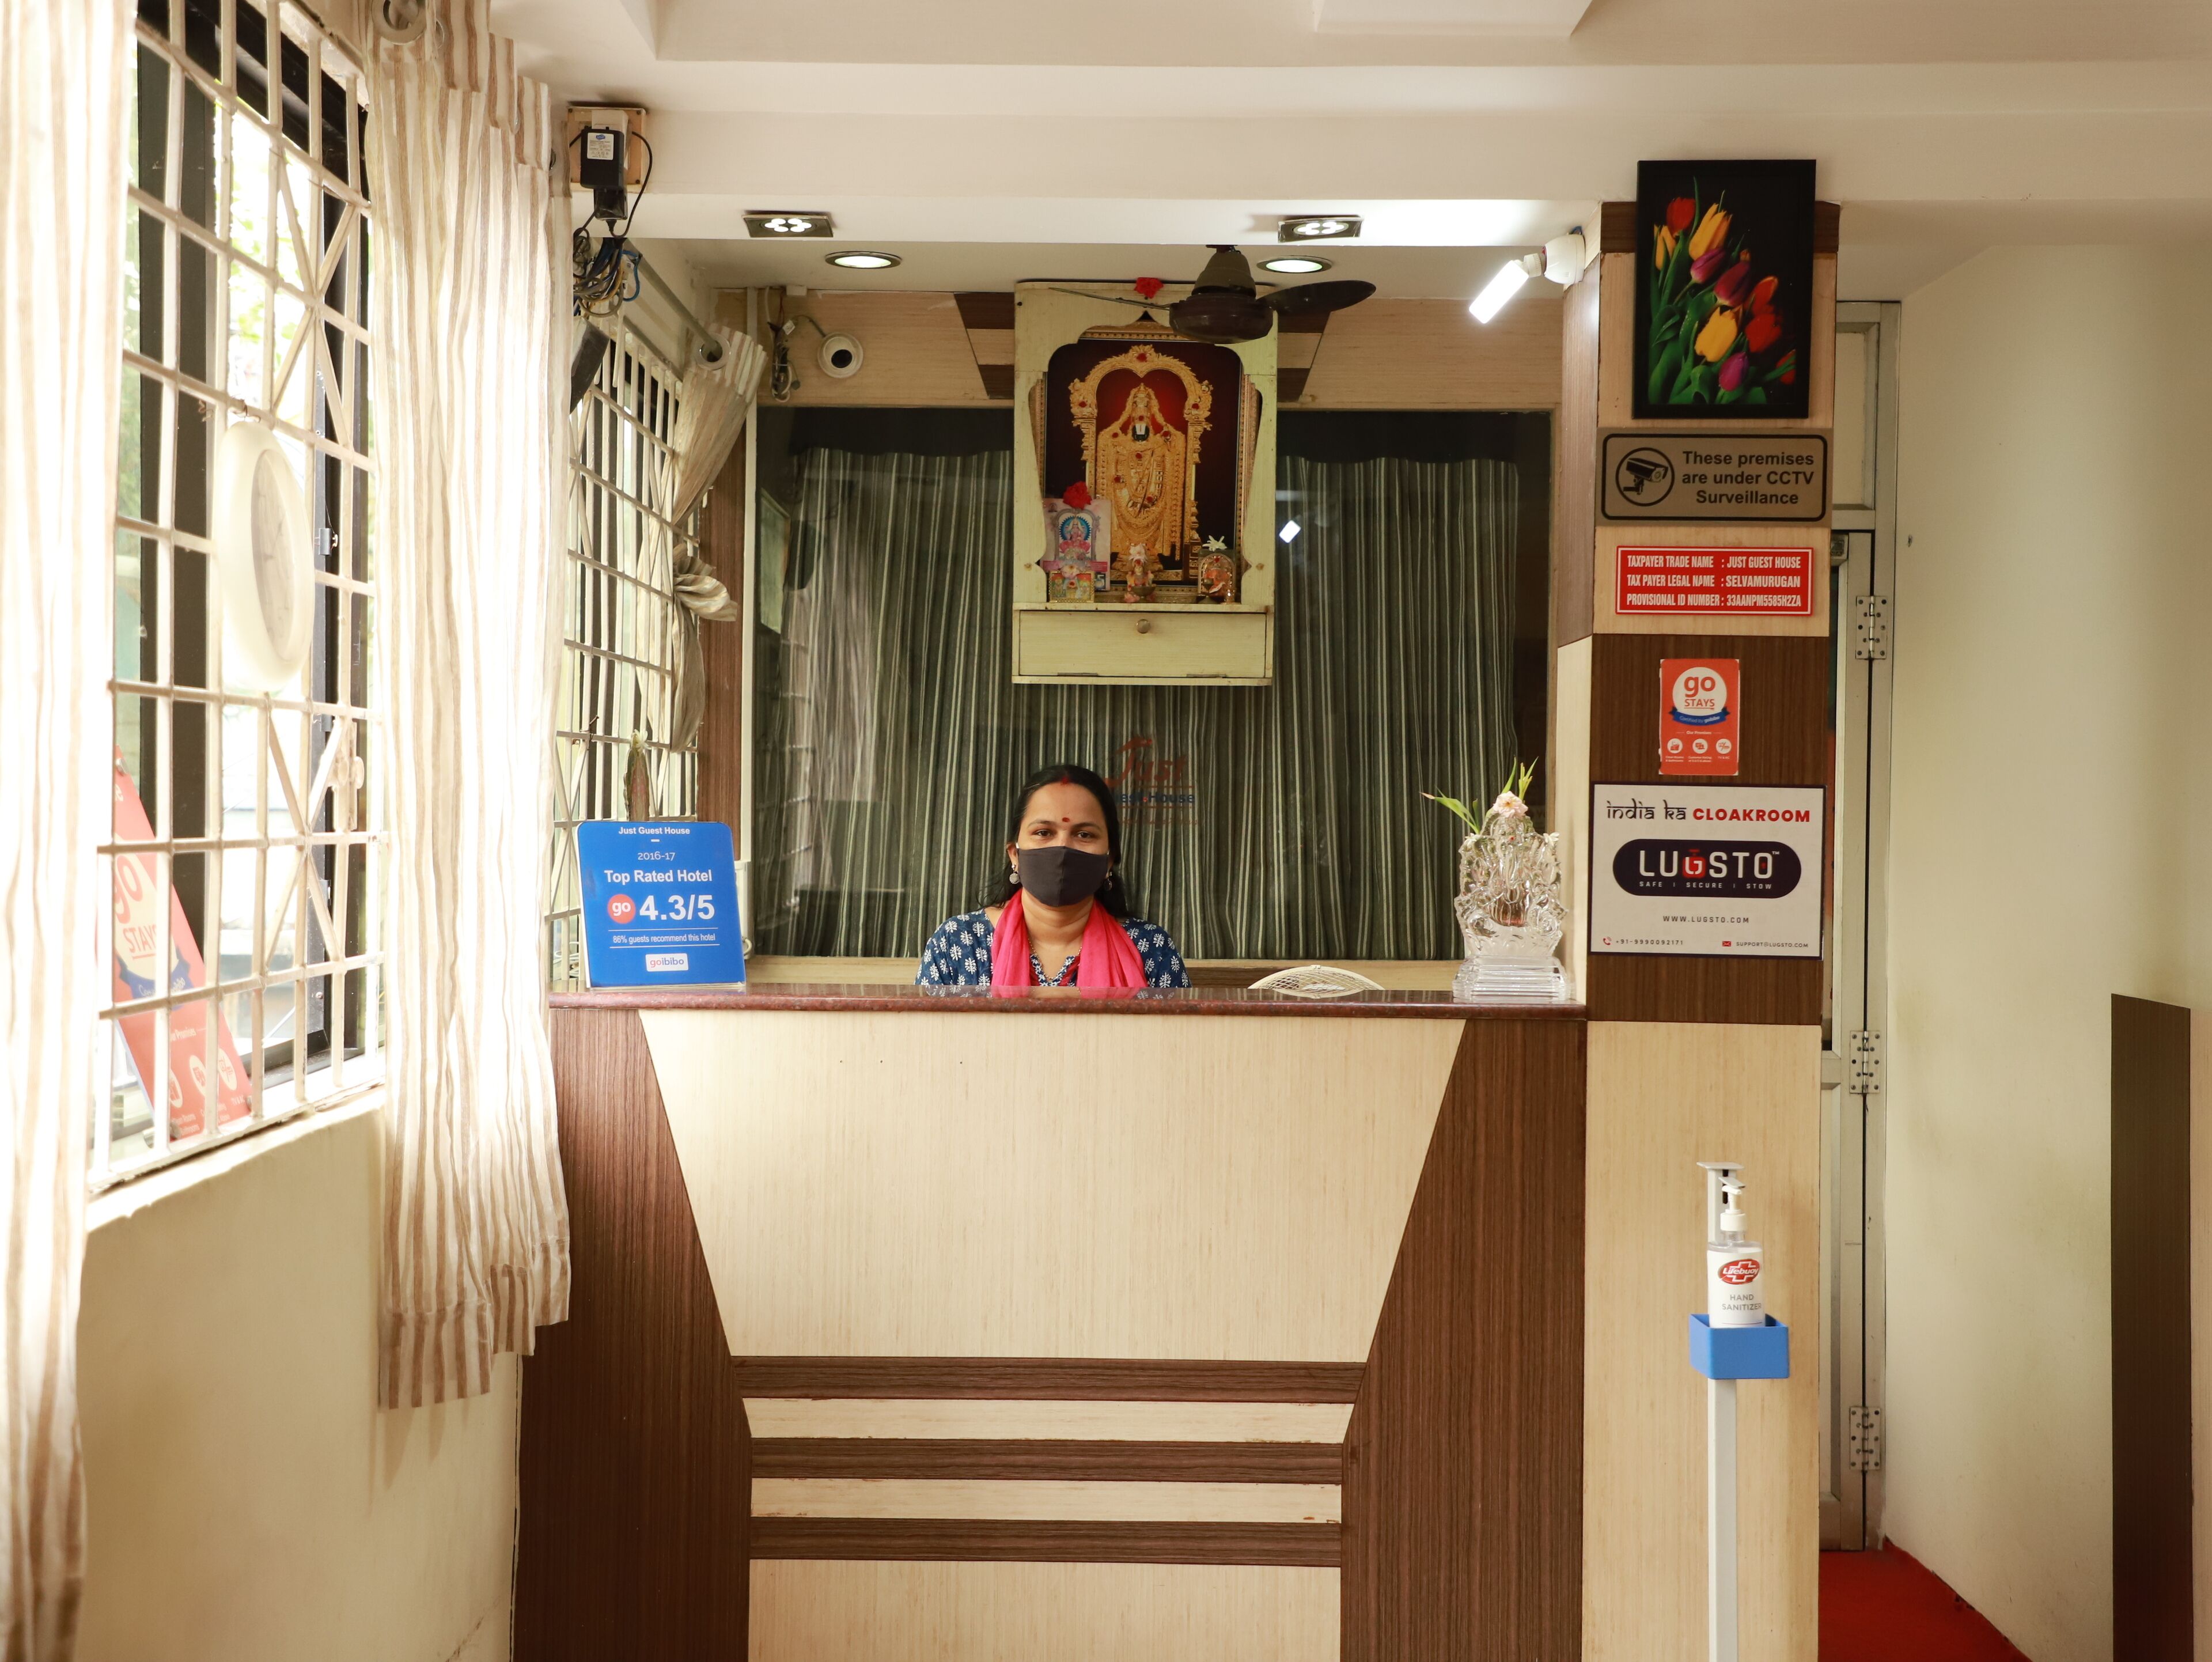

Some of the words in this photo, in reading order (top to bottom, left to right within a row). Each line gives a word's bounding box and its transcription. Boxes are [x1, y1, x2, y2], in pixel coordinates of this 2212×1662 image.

[1683, 451, 1733, 465] These
[1738, 452, 1814, 468] premises
[1682, 473, 1707, 484] are
[1714, 471, 1762, 484] under
[1766, 471, 1815, 485] CCTV
[1696, 490, 1799, 504] Surveillance
[1627, 555, 1665, 567] TAXPAYER
[1665, 556, 1690, 567] TRADE
[1691, 556, 1714, 568] NAME
[1727, 556, 1747, 568] JUST
[1748, 556, 1774, 568] GUEST
[1775, 556, 1801, 569] HOUSE
[1627, 574, 1641, 586] TAX
[1642, 574, 1666, 586] PAYER
[1668, 575, 1691, 586] LEGAL
[1692, 575, 1715, 587] NAME
[1725, 576, 1801, 588] SELVAMURUGAN
[1627, 593, 1676, 605] PROVISIONAL
[1677, 594, 1685, 605] ID
[1688, 594, 1719, 606] NUMBER
[1684, 676, 1716, 698] go
[1684, 699, 1715, 707] STAYS
[1149, 792, 1195, 803] House
[1607, 798, 1655, 820] india
[1664, 799, 1687, 820] ka
[1692, 808, 1810, 823] CLOAKROOM
[664, 827, 690, 835] House
[638, 851, 675, 861] 2016-17
[604, 870, 630, 885] Top
[634, 870, 673, 882] Rated
[677, 869, 713, 882] Hotel
[612, 902, 631, 917] go
[639, 894, 715, 921] 4.3/5
[1663, 915, 1749, 924] WWW.LUGSTO.COM
[628, 936, 650, 945] guests
[651, 934, 687, 943] recommend
[688, 934, 699, 942] this
[700, 933, 715, 941] hotel
[650, 957, 684, 968] goibibo
